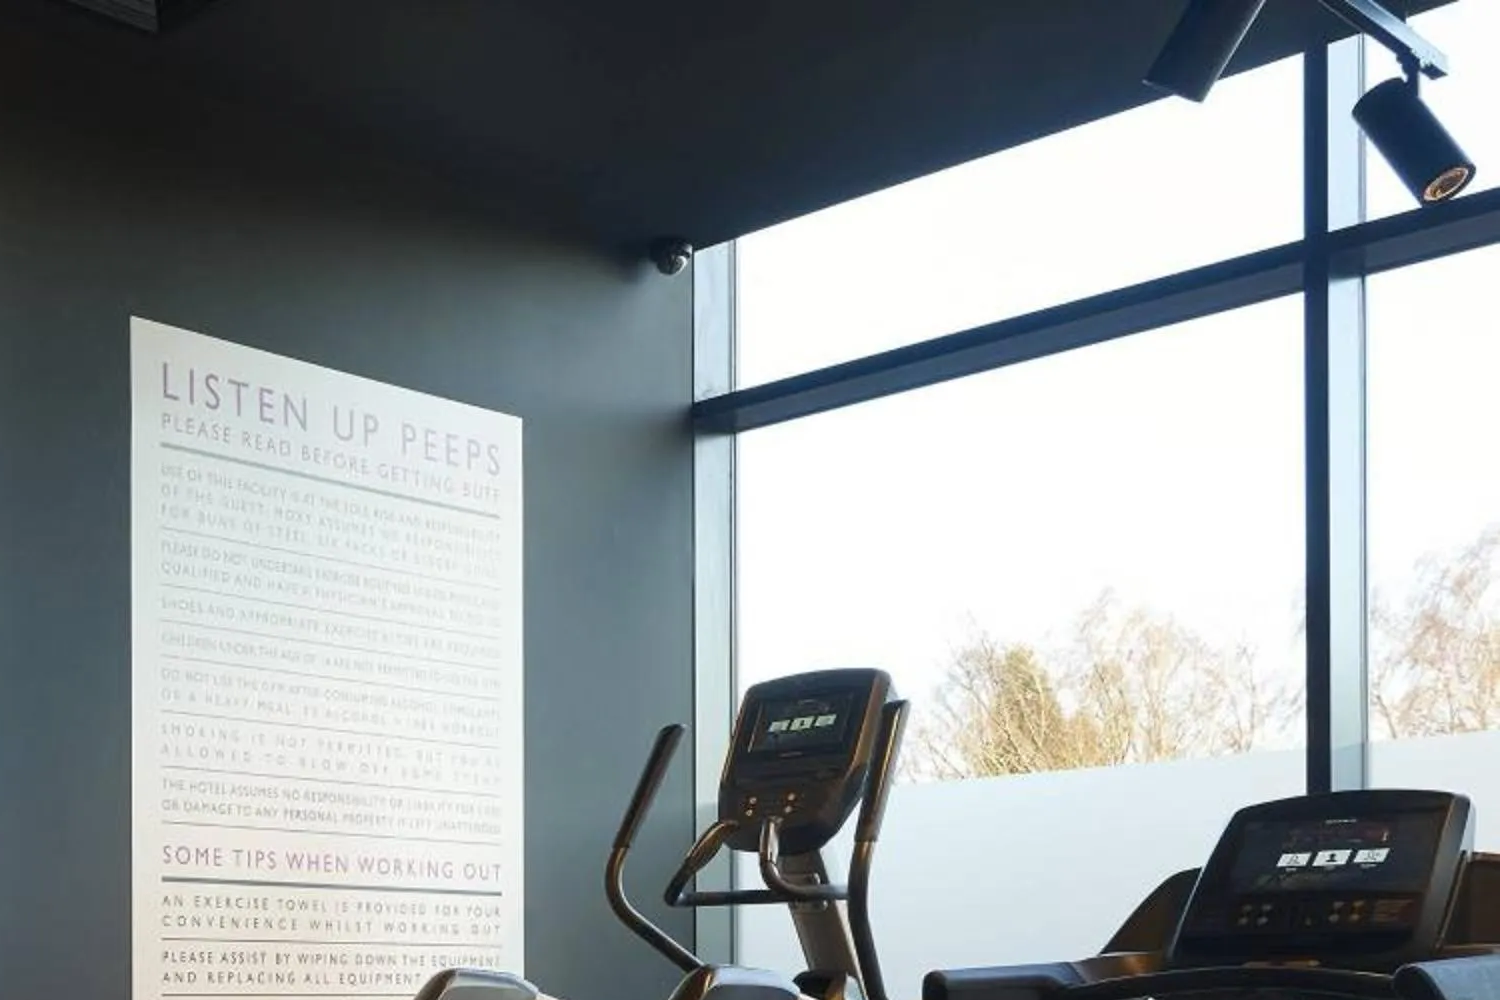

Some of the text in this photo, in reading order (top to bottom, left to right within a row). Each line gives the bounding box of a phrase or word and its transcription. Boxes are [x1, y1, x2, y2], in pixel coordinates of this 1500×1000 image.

[162, 362, 500, 477] LISTEN UP PEEPS
[161, 411, 500, 504] PLEASE READ BEFORE GETTING BUFF
[238, 478, 286, 501] FACILITY
[161, 559, 229, 584] QUALIFIED
[234, 571, 260, 589] AND
[207, 602, 234, 620] AND
[161, 721, 240, 743] SMOKING
[162, 777, 185, 792] THE
[189, 779, 228, 796] HOTEL
[230, 783, 279, 800] ASSUMES
[283, 787, 299, 802] NO
[161, 797, 178, 812] OR
[183, 799, 231, 816] DAMAGE
[237, 803, 251, 818] TO
[254, 804, 278, 820] ANY
[284, 807, 337, 824] PERSONAL
[162, 844, 501, 881] SOME TIPS WHEN WORKING OUT
[161, 894, 501, 918] AN EXERCISE TOWEL IS PROVIDED FOR YOUR
[161, 913, 500, 936] CONVENIENCE WHILST WORKING OUT
[162, 950, 500, 967] PLEASE ASSIST BY WIPING DOWN THE EQUIPMENT
[162, 970, 420, 985] AND REPLACING ALL EQUIPMENT
